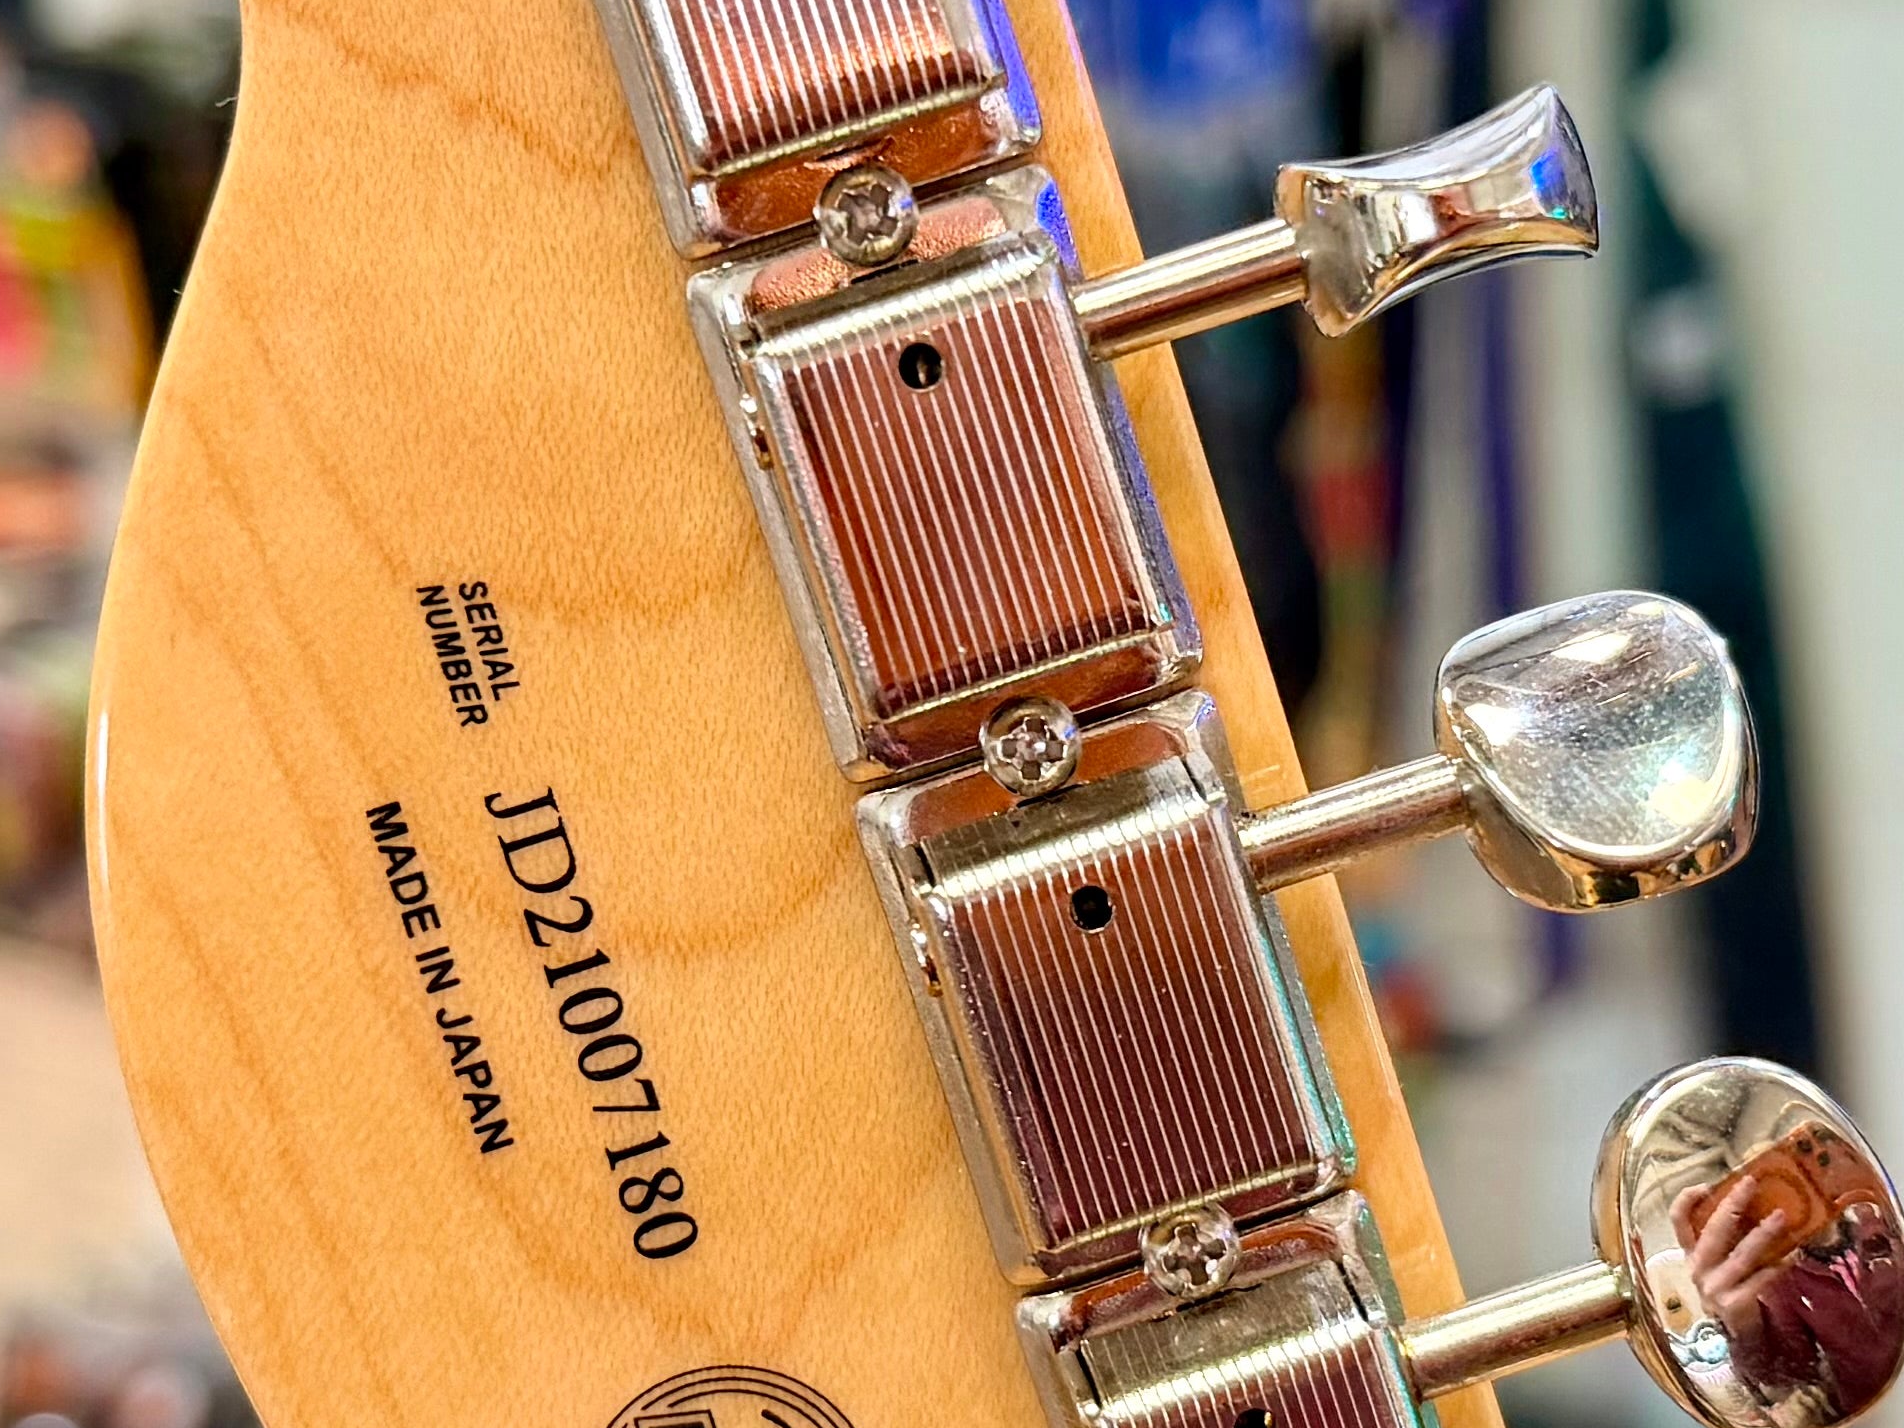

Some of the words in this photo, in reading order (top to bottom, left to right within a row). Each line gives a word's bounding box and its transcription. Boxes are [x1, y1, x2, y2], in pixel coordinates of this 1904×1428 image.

[414, 583, 490, 729] NUMBER
[457, 579, 522, 703] SERIAL
[364, 799, 443, 940] MADE
[413, 944, 462, 996] IN
[482, 785, 700, 1261] JD21007180
[434, 1006, 516, 1156] JAPAN
